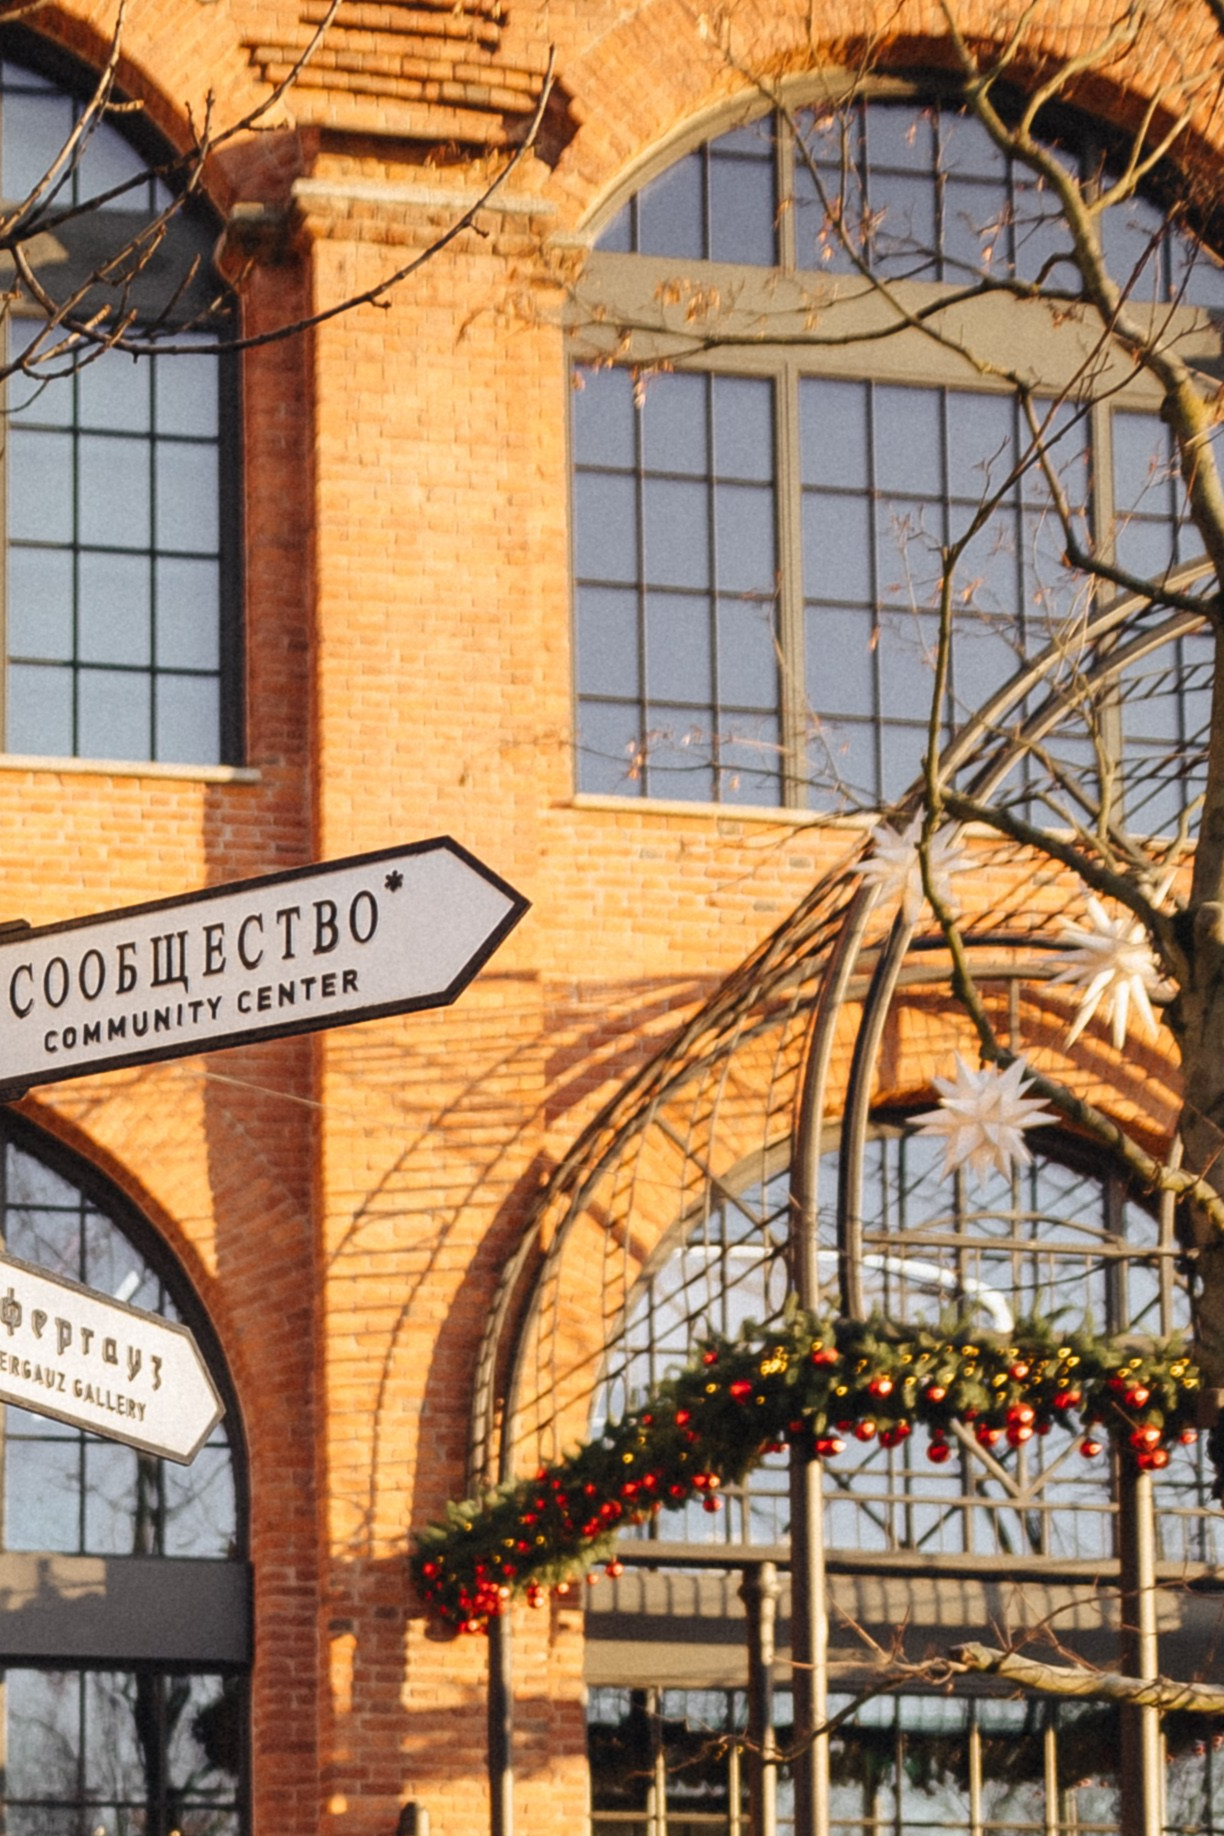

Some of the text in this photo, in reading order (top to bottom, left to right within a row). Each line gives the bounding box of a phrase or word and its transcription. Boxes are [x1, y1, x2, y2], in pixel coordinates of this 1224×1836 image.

[44, 967, 360, 1053] COMMUNITY CENTER
[71, 1377, 147, 1423] GALLERY
